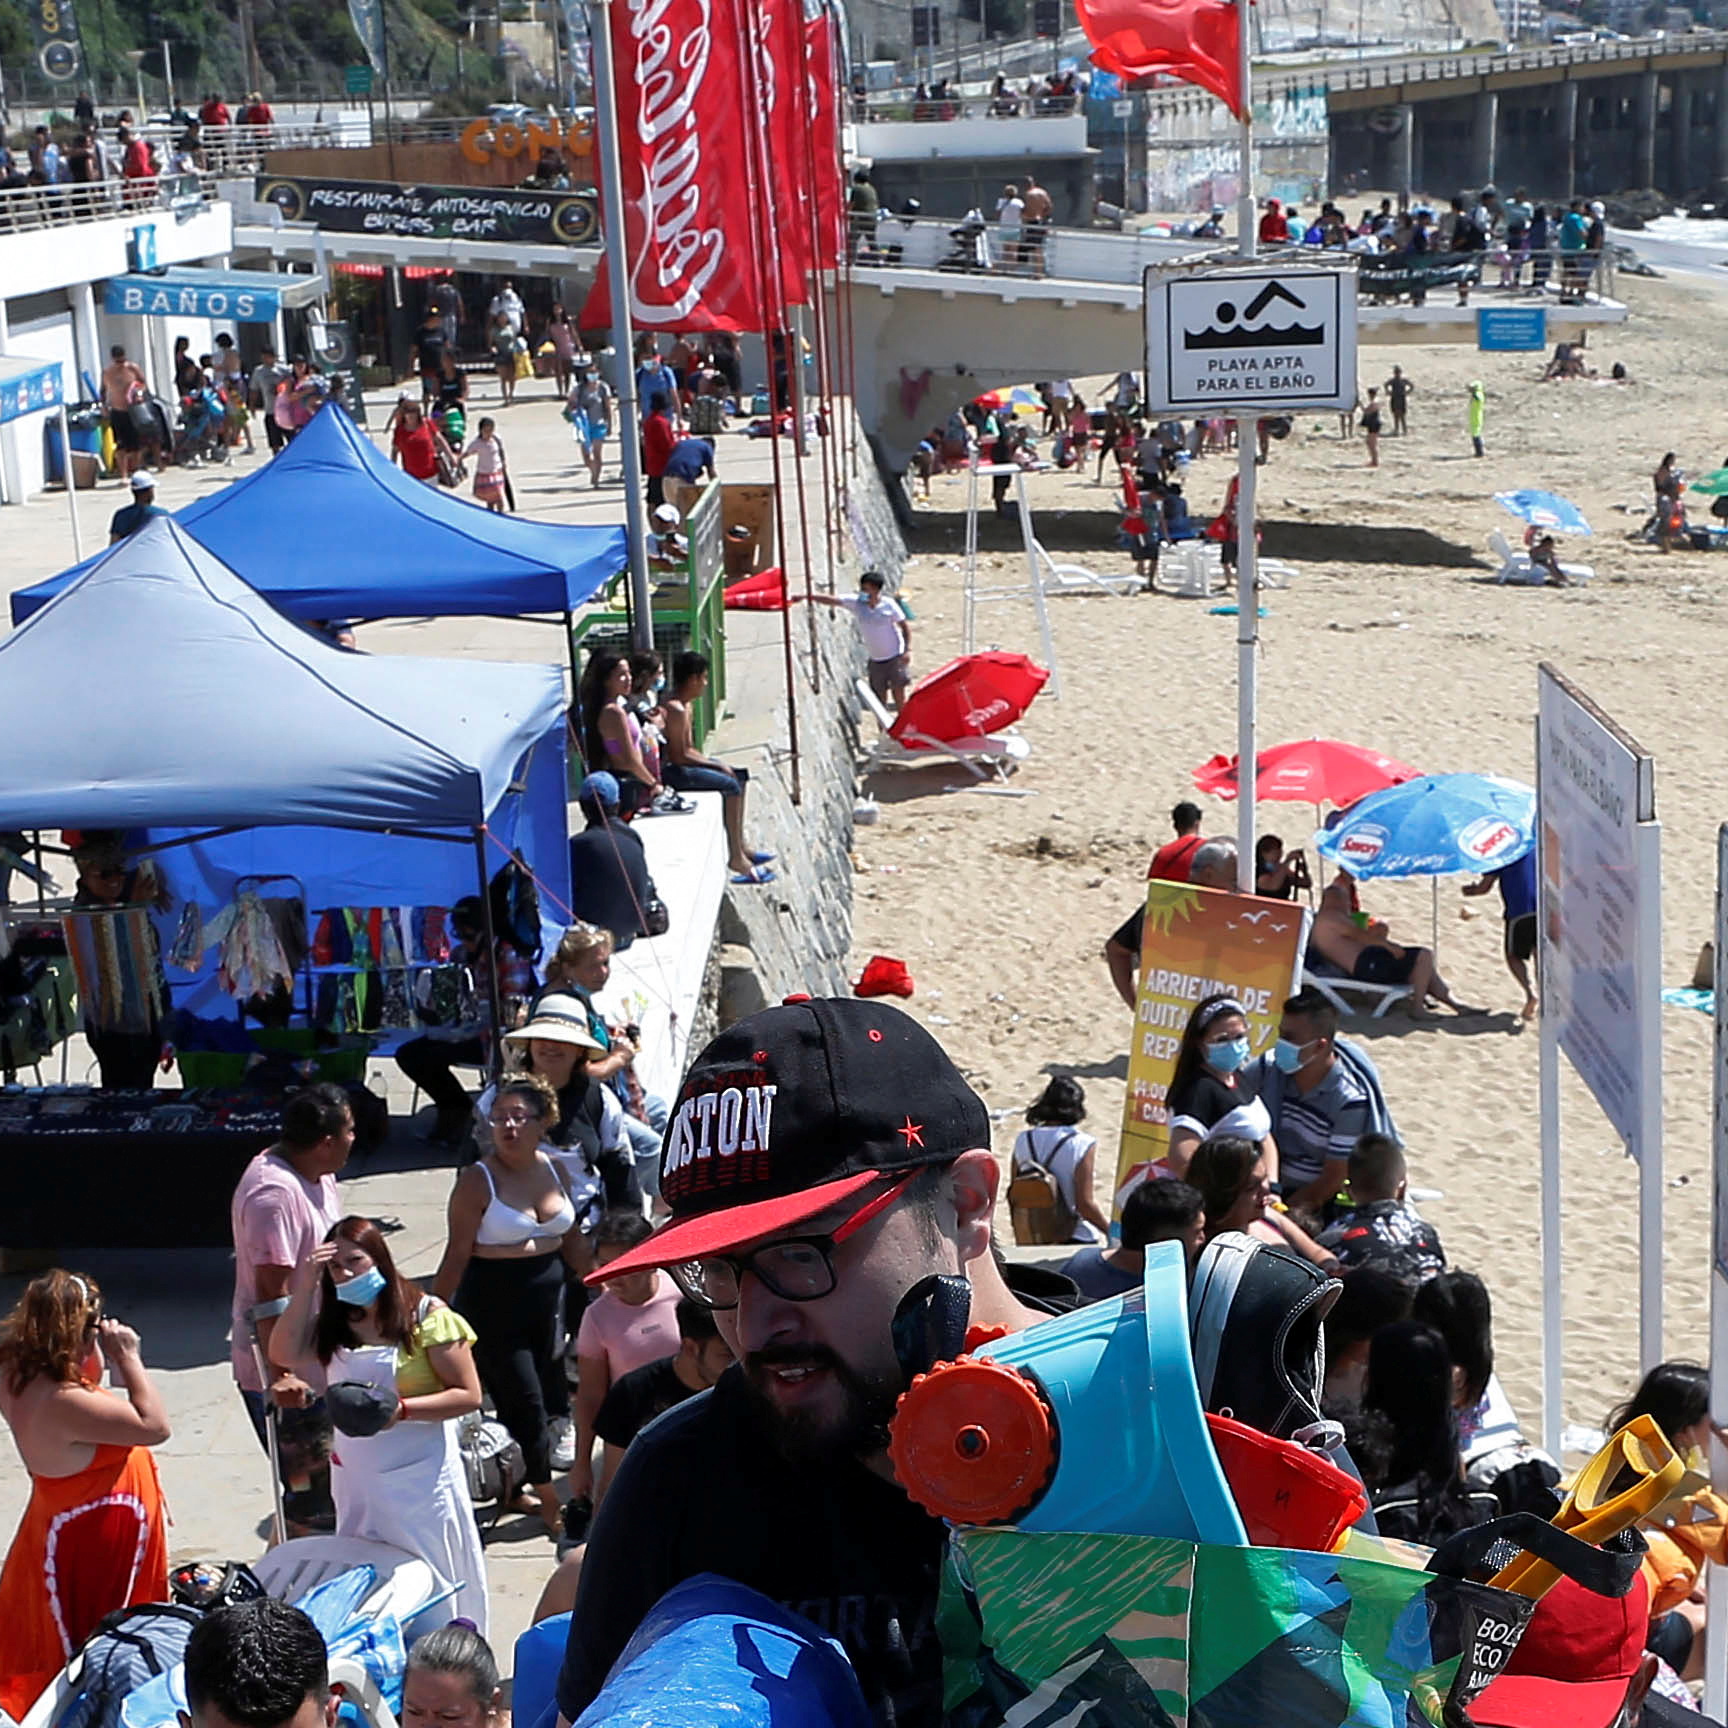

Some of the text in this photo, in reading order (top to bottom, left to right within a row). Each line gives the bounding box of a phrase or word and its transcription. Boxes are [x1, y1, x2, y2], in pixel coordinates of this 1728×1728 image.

[428, 198, 551, 219] AUTOSERVICIO
[452, 217, 496, 235] BAR
[124, 287, 256, 318] BAÑOS
[1208, 356, 1304, 372] PLAYA APTA
[1197, 373, 1315, 391] PARA EL BAÑO
[1242, 987, 1271, 1015] DE
[1255, 1023, 1273, 1047] Y
[1472, 1642, 1502, 1669] ECO
